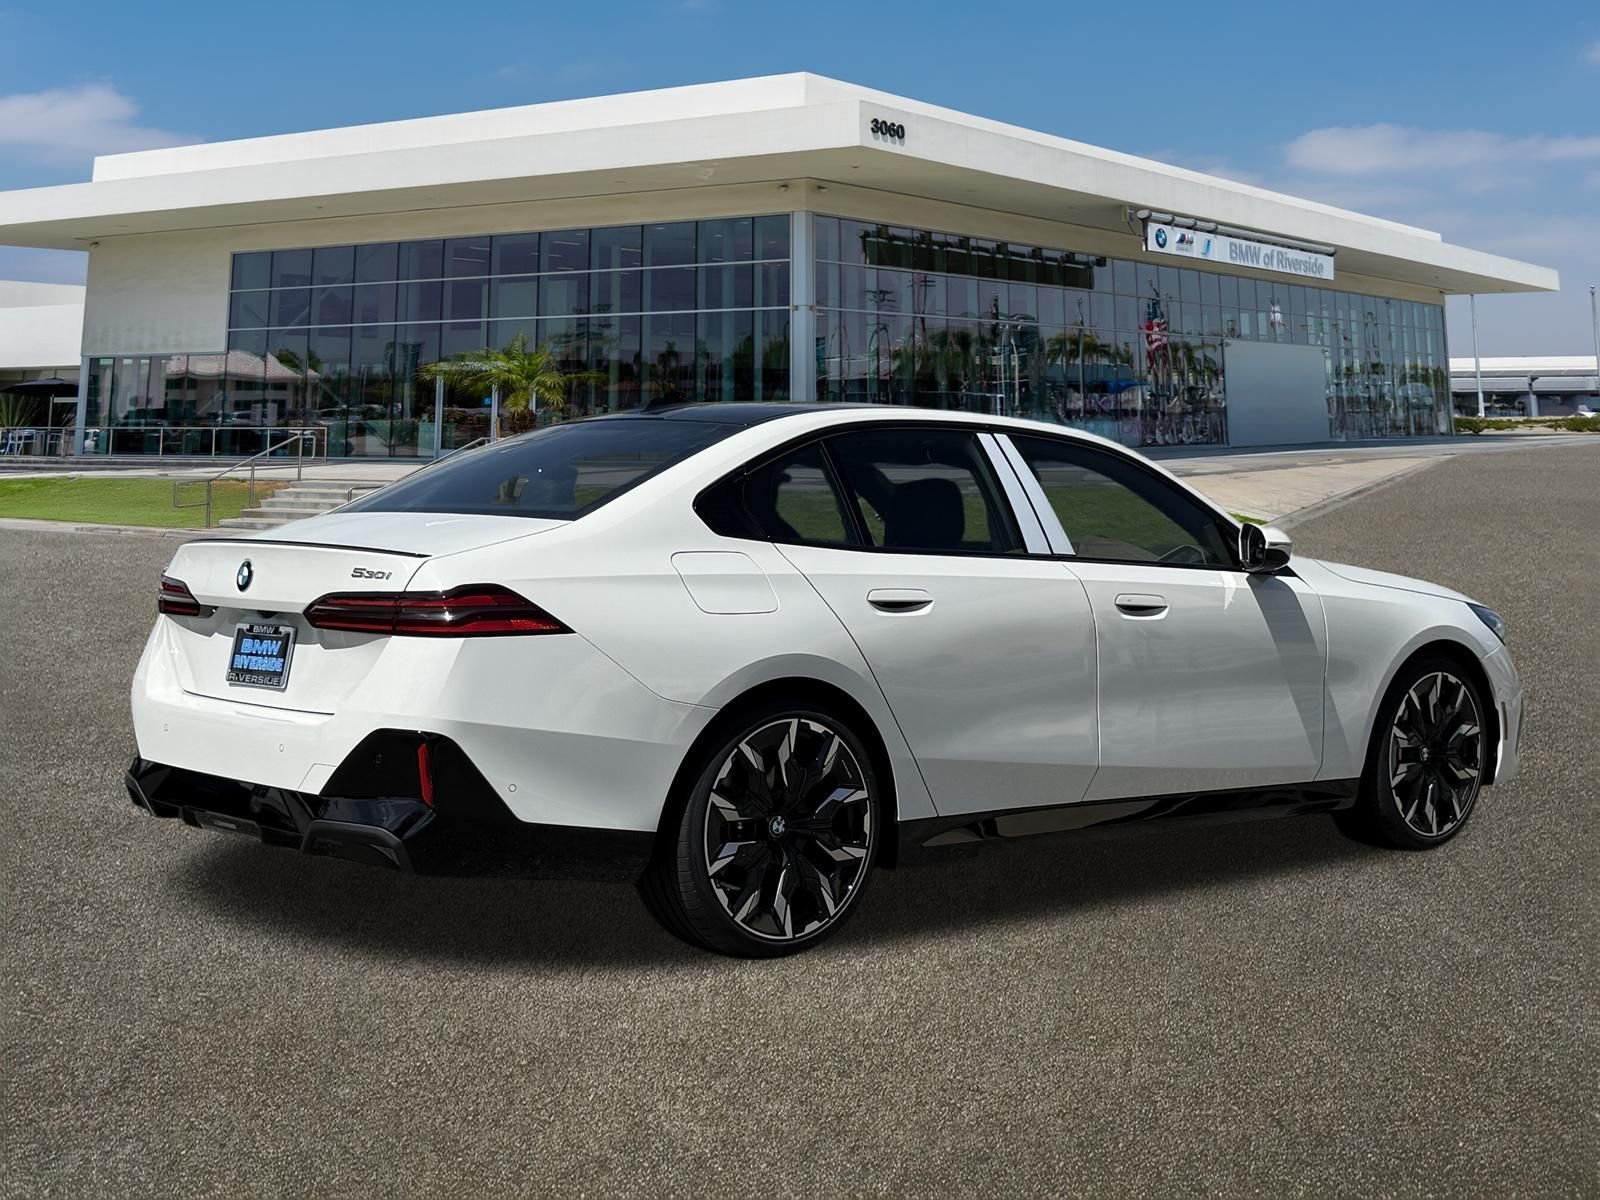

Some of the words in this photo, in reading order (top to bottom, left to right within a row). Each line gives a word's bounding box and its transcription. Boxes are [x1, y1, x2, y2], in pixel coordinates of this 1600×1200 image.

[871, 118, 905, 140] 3060
[1229, 241, 1261, 265] BMW
[1263, 248, 1275, 267] of
[1277, 250, 1325, 275] Riverside
[351, 567, 392, 580] 530i
[253, 625, 275, 634] BMW
[241, 638, 282, 655] BMW
[228, 672, 280, 686] RIVERSIDE
